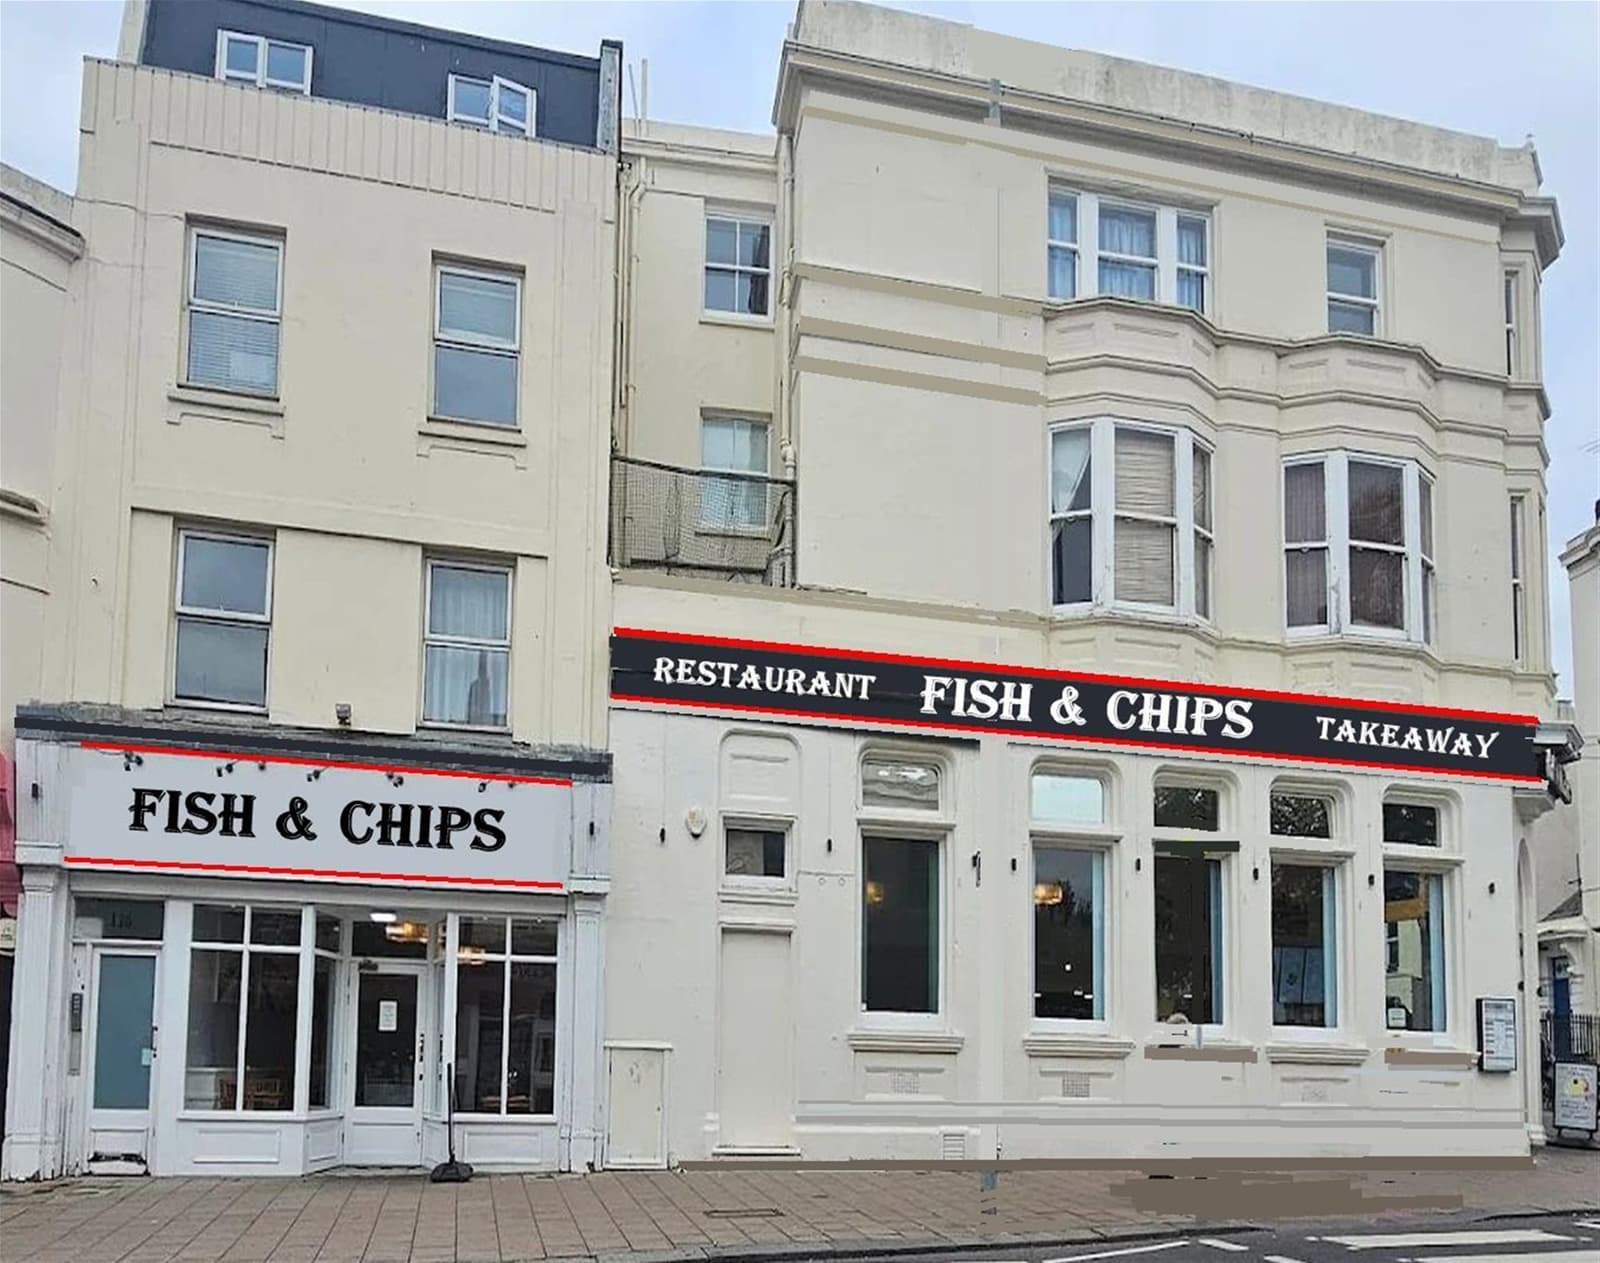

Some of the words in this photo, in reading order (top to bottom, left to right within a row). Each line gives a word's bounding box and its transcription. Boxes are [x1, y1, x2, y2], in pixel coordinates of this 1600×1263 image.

[653, 656, 876, 700] RESTAURANT
[920, 675, 1034, 722] FISH
[1050, 685, 1088, 727] &
[1106, 690, 1255, 740] CHIPS
[1315, 716, 1500, 759] TAKEAWAY
[128, 788, 257, 838] FISH
[275, 796, 318, 842] &
[338, 799, 507, 853] CHIPS
